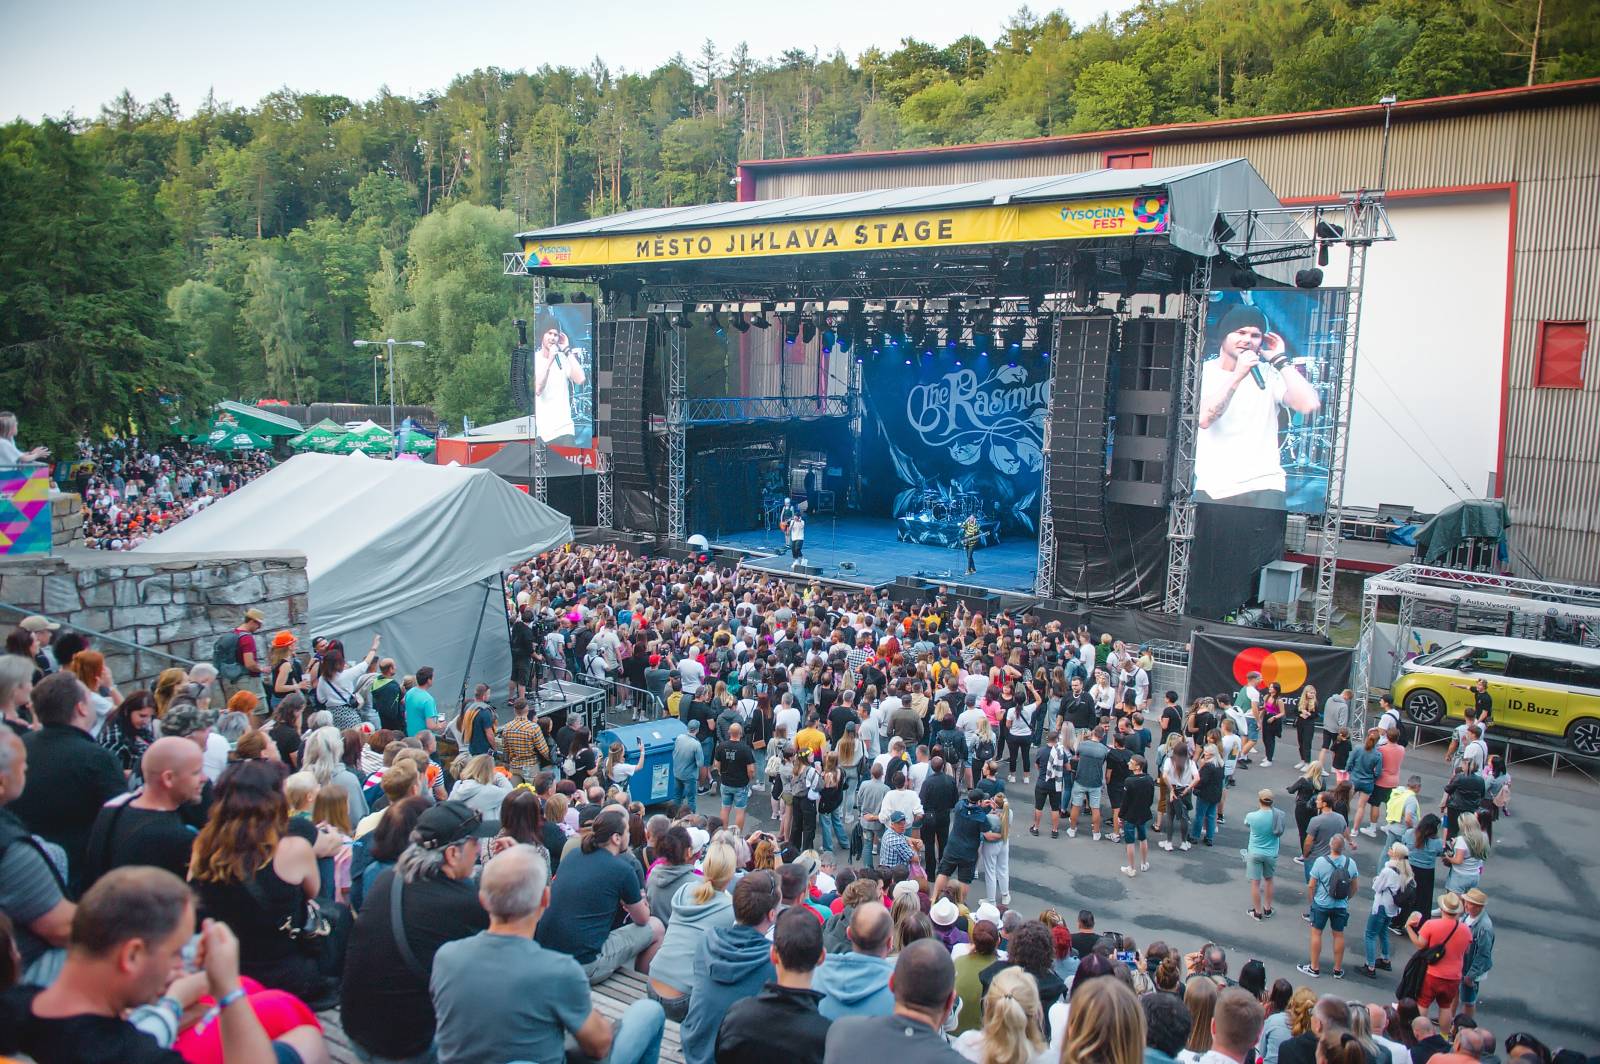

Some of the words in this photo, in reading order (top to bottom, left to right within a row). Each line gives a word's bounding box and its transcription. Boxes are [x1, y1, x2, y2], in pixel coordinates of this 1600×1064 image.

[1093, 218, 1125, 229] FEST
[636, 234, 712, 258] MĚSTO
[725, 226, 839, 253] JIHLAVA
[854, 218, 954, 245] STAGE
[906, 383, 949, 433] The
[1465, 598, 1485, 606] Auto
[1564, 611, 1585, 620] Auto
[1508, 698, 1560, 717] ID.Buzz
